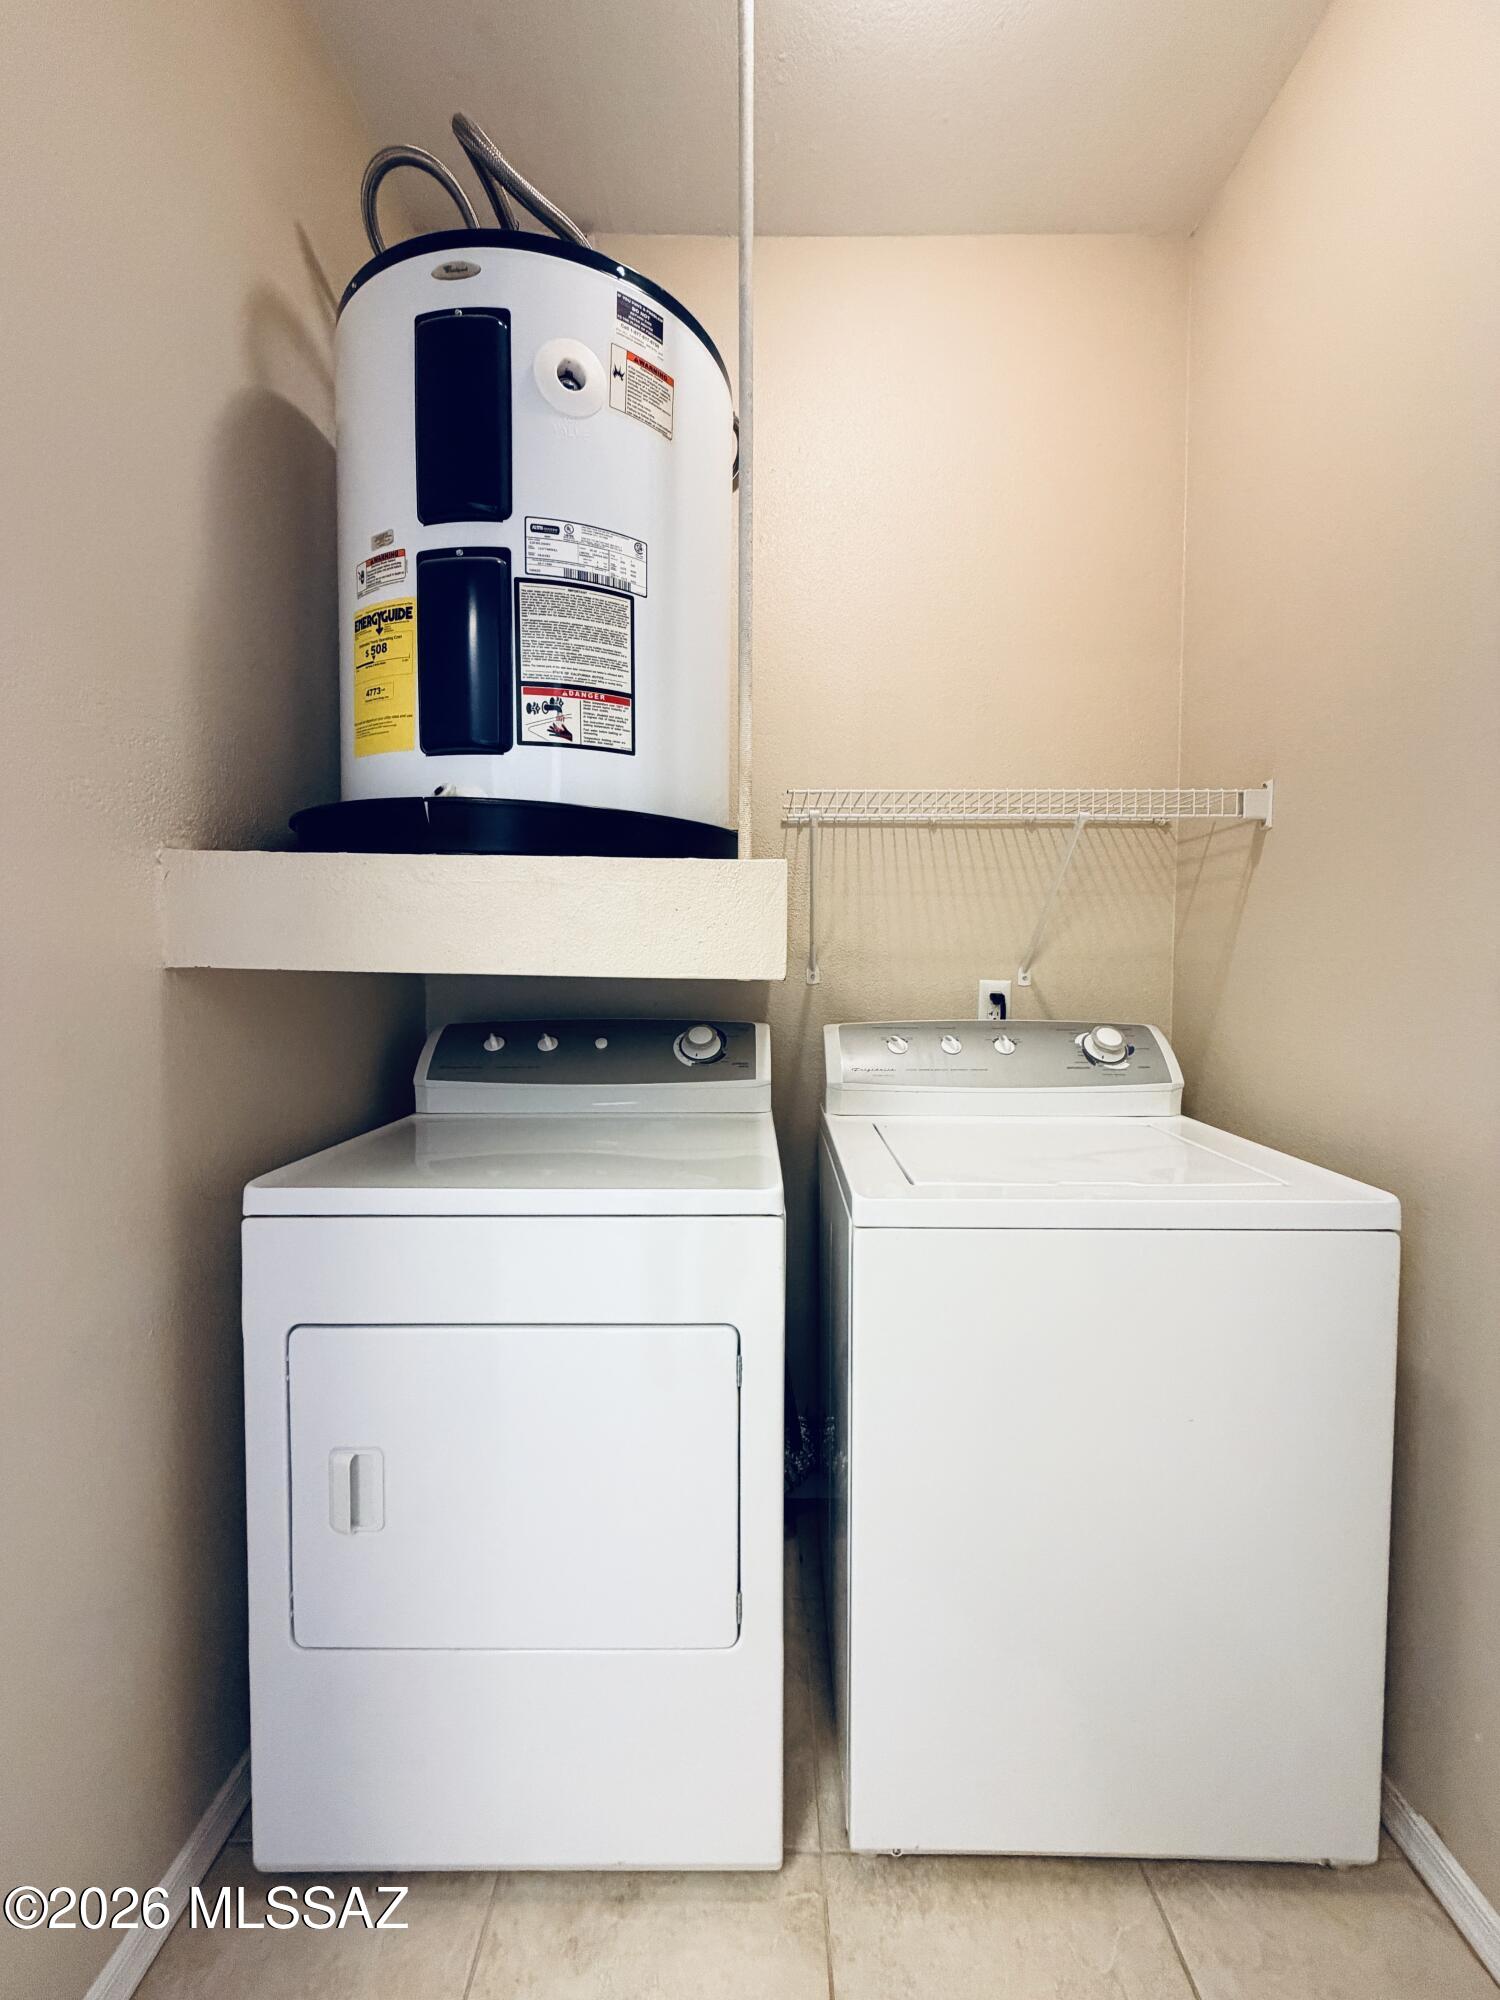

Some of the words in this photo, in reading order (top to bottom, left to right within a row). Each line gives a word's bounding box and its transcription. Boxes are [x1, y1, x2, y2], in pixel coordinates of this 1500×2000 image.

[639, 358, 668, 381] WARNING
[370, 642, 388, 656] 508
[568, 690, 606, 701] DANGER
